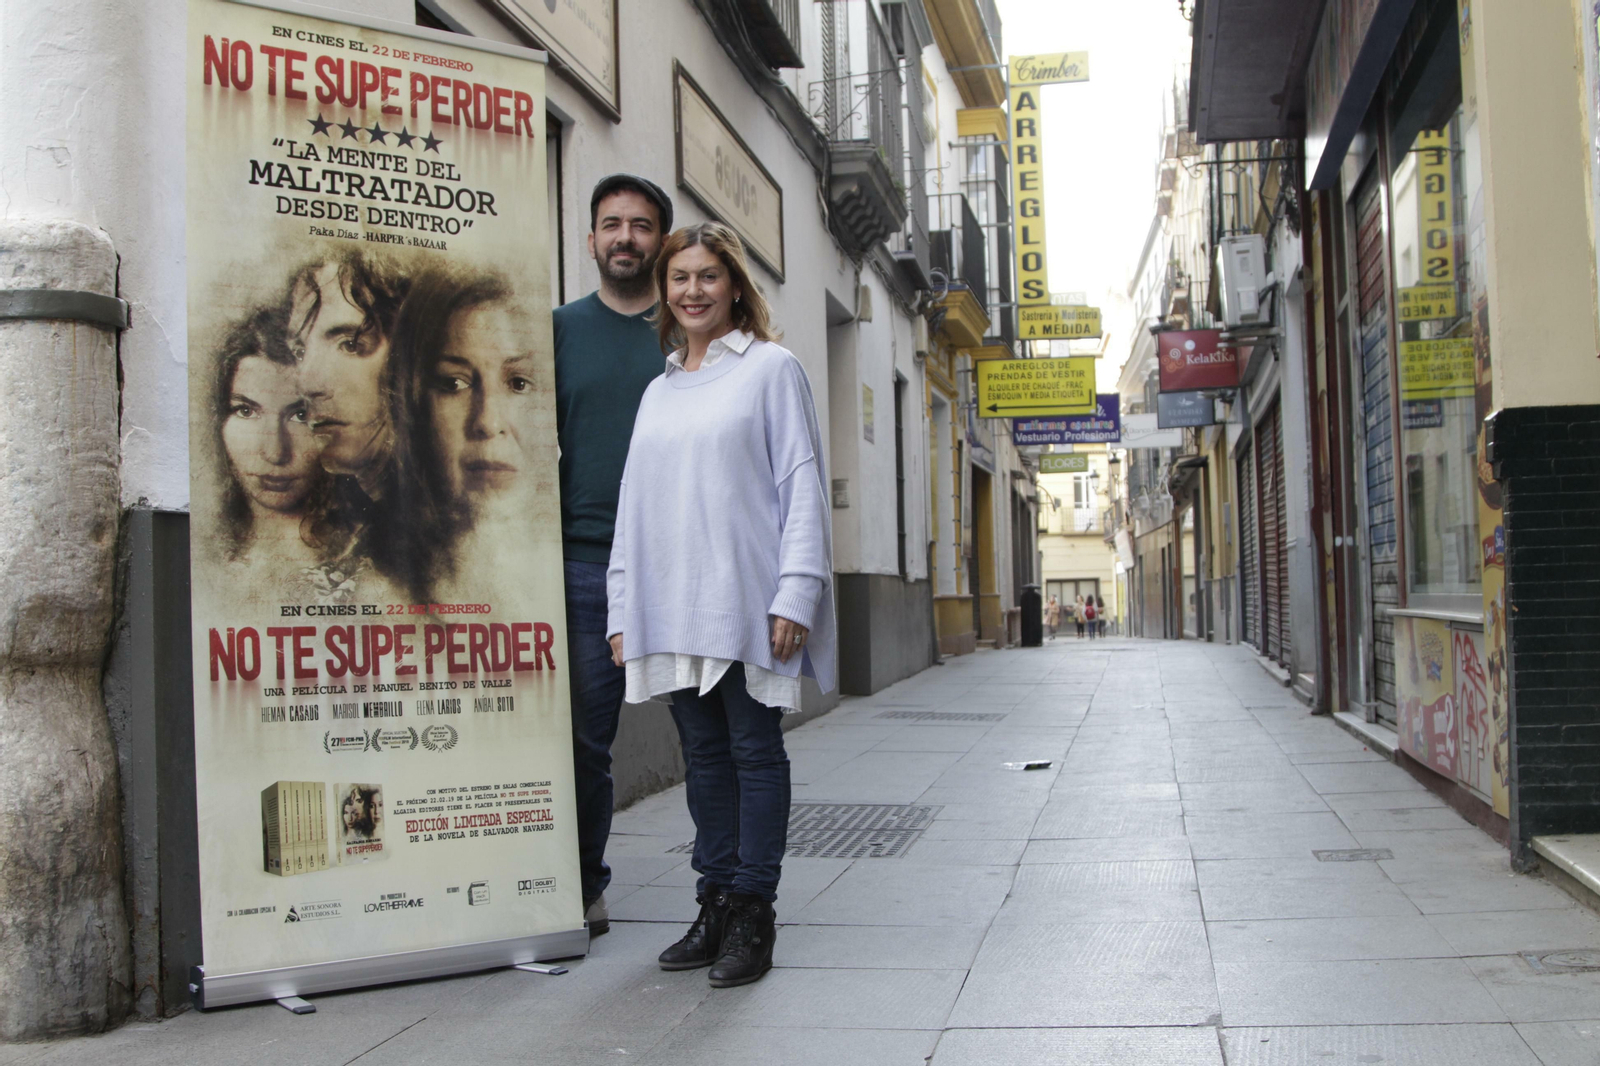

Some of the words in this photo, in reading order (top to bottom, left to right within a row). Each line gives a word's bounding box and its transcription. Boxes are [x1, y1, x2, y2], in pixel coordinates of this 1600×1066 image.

[271, 25, 292, 39] EN
[296, 30, 345, 49] CINES
[348, 39, 368, 53] EL
[372, 44, 389, 56] 22
[392, 47, 410, 61] DE
[413, 52, 474, 73] FEBRERO
[1014, 53, 1079, 81] Trimber
[203, 33, 254, 92] NO
[260, 44, 308, 101] TE
[315, 55, 403, 116] SUPE
[409, 71, 535, 139] PERDER
[327, 145, 408, 173] MENTE
[415, 159, 461, 182] DEL
[248, 160, 498, 216] MALTRATADOR
[1015, 91, 1045, 299] ARREGLOS
[275, 195, 359, 223] DESDE
[309, 225, 334, 237] Paka
[336, 228, 359, 240] Díaz
[412, 236, 448, 251] BAZAAR
[1021, 310, 1052, 321] Sastreria
[1054, 312, 1059, 322] y
[1061, 309, 1098, 320] Modisteria
[1028, 325, 1036, 335] A
[1042, 323, 1091, 335] MEDIDA
[987, 371, 1033, 381] PRENDAS
[1036, 371, 1048, 379] DE
[1051, 369, 1085, 378] VESTIR
[1002, 361, 1055, 371] ARREGLOS
[1058, 360, 1070, 369] DE
[987, 392, 1022, 401] ESMOQUIN
[1024, 391, 1028, 400] Y
[1030, 390, 1050, 399] MEDIA
[1052, 389, 1084, 399] ETIQUETA
[988, 383, 1020, 392] ALQUILER
[1022, 382, 1031, 391] DE
[1066, 380, 1084, 389] FRAC
[1015, 432, 1061, 442] Vestuario
[1064, 430, 1119, 441] Profesional
[1041, 458, 1085, 469] FLORES
[280, 605, 302, 617] EN
[305, 604, 357, 616] CINES
[361, 603, 382, 615] EL
[386, 604, 404, 615] 22
[407, 603, 426, 615] DE
[430, 603, 492, 614] FEBRERO
[208, 626, 262, 681] NO
[266, 625, 319, 680] TE
[324, 623, 419, 679] SUPE
[424, 621, 556, 675] PERDER
[264, 688, 285, 697] UNA
[292, 683, 347, 696] PELÍCULA
[353, 684, 367, 694] DE
[373, 682, 414, 693] MANUEL
[419, 680, 457, 691] BENITO
[462, 680, 476, 689] DE
[481, 679, 512, 689] VALLE
[416, 700, 435, 716] ELENA
[497, 696, 515, 712] SOTO
[405, 813, 449, 833] EDICIÓN
[453, 812, 502, 829] LIMITADA
[506, 808, 554, 825] ESPECIAL
[409, 835, 420, 843] DE
[424, 834, 434, 842] LA
[437, 831, 466, 841] NOVELA
[469, 829, 479, 837] DE
[483, 826, 519, 837] SALVADOR
[522, 823, 554, 833] NAVARRO
[300, 904, 316, 912] ARTE
[316, 902, 342, 910] SONORA
[300, 911, 331, 919] ESTUDIOS
